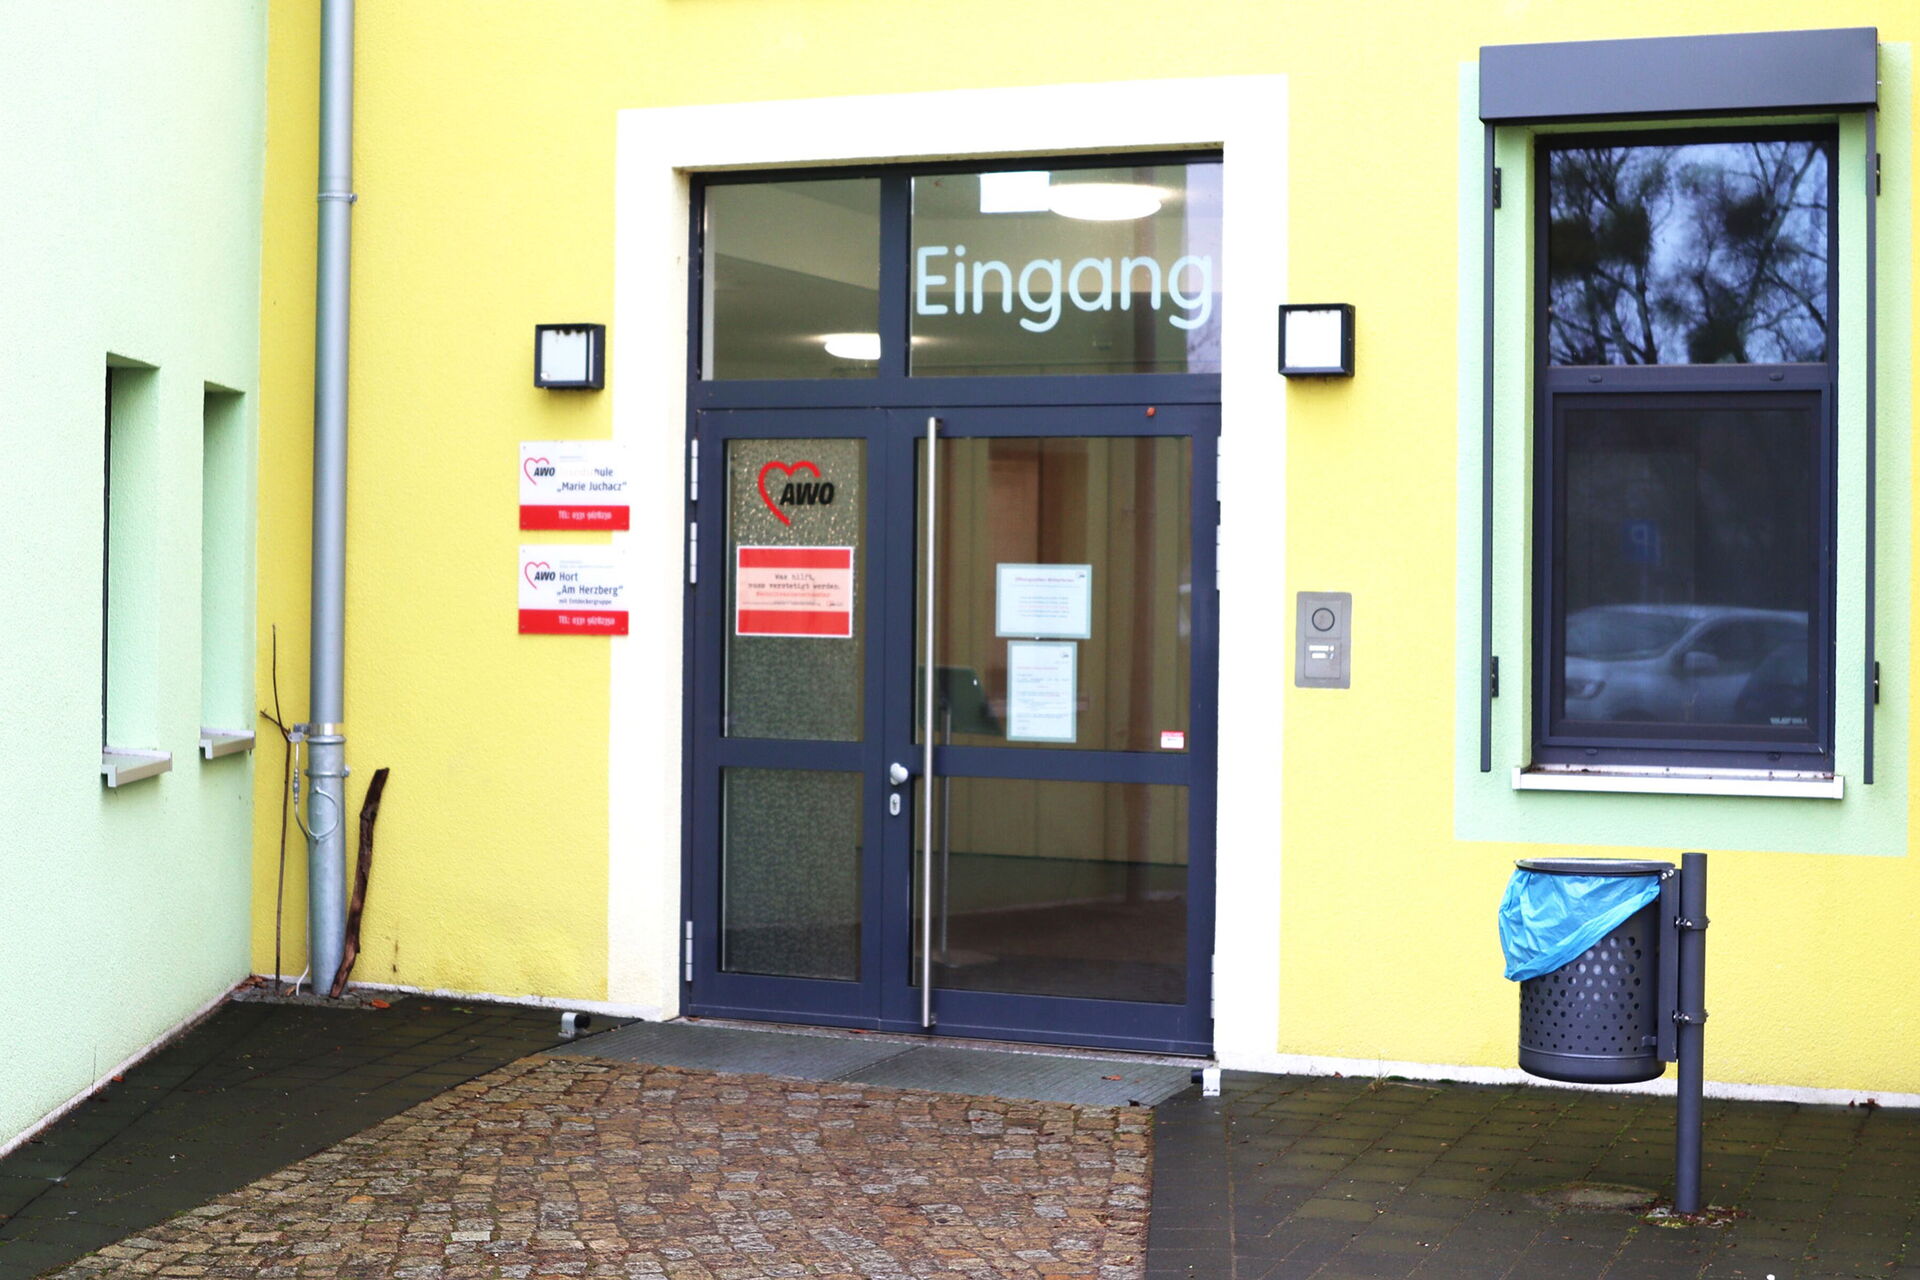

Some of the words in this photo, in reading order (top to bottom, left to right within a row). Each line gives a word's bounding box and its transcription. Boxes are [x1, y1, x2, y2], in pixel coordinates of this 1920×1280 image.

[917, 245, 1212, 333] Eingang
[533, 467, 555, 477] AWO
[780, 482, 835, 506] AWO
[534, 571, 556, 581] AWO
[559, 572, 578, 581] Hort
